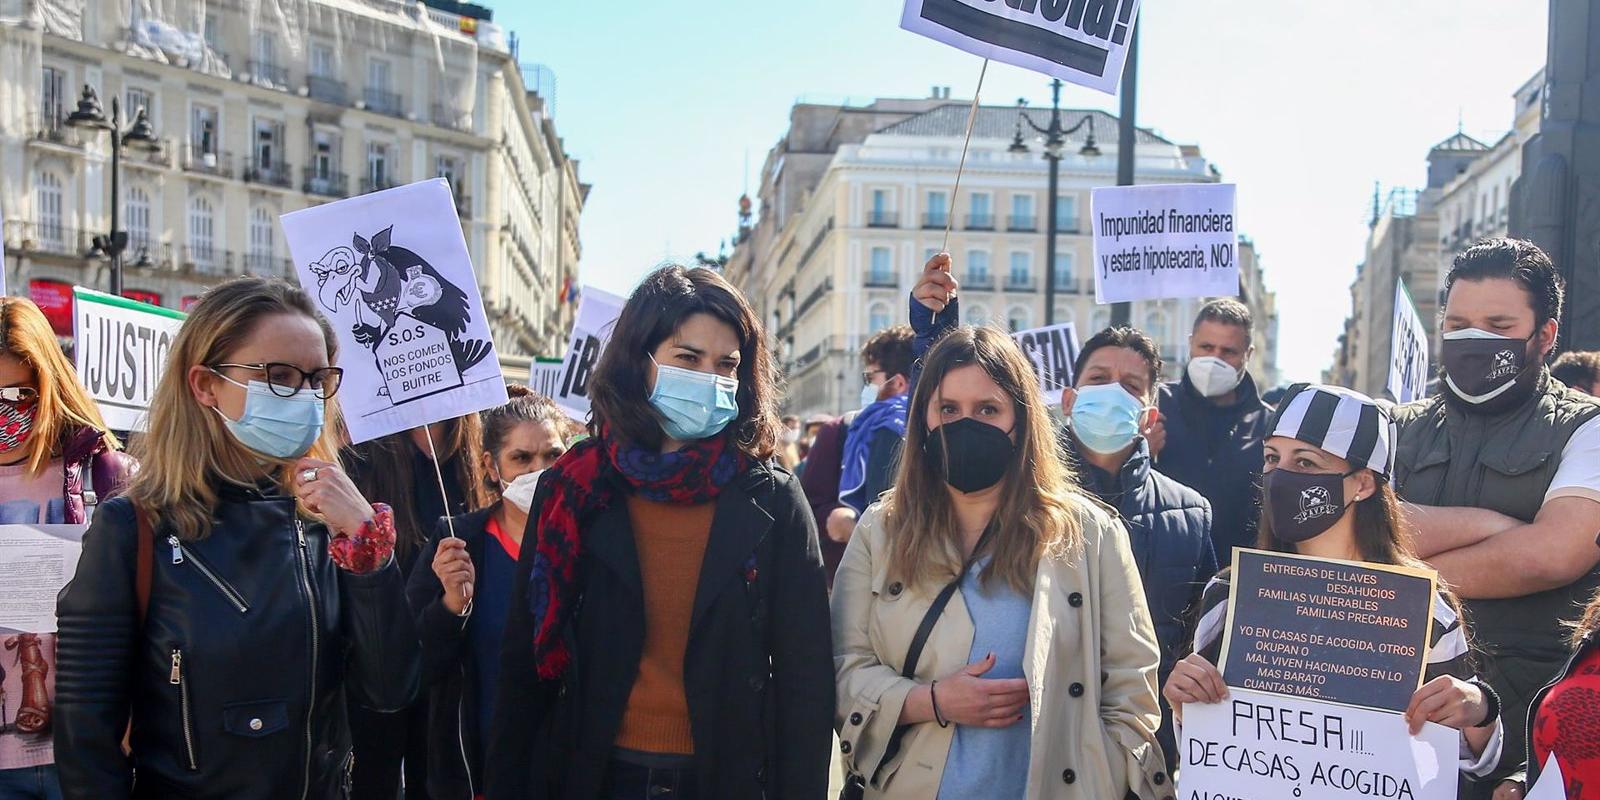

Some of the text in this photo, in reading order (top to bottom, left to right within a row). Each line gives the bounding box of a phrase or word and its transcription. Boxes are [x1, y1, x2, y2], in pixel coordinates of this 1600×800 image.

[1100, 208, 1233, 242] Impunidad financiera
[1101, 243, 1233, 279] y estafa hipotecaria, NO!
[388, 325, 425, 346] S.O.S
[84, 313, 172, 401] ¡JUSTIC
[383, 342, 445, 368] NOS COMEN
[385, 353, 452, 381] LOS FONDOS
[1019, 328, 1074, 391] STA!
[402, 371, 443, 392] BUITRE
[1263, 563, 1377, 585] ENTREGAS DE LLAVES
[1258, 588, 1379, 612] FAMILIAS VUNERABLES
[1326, 583, 1396, 600] DESAHUCIOS
[1296, 606, 1408, 629] FAMILIAS PRECARIAS
[1239, 625, 1416, 657] YO EN CASAS DE ACOGIDA, OTROS
[1255, 640, 1309, 657] OKUPAN O
[1245, 652, 1402, 682] MAL VIVEN HACINADOS EN LO
[1257, 667, 1326, 685] MAS BARATO
[1244, 678, 1293, 694] CUANTAS
[1311, 761, 1415, 800] ACOGIDA
